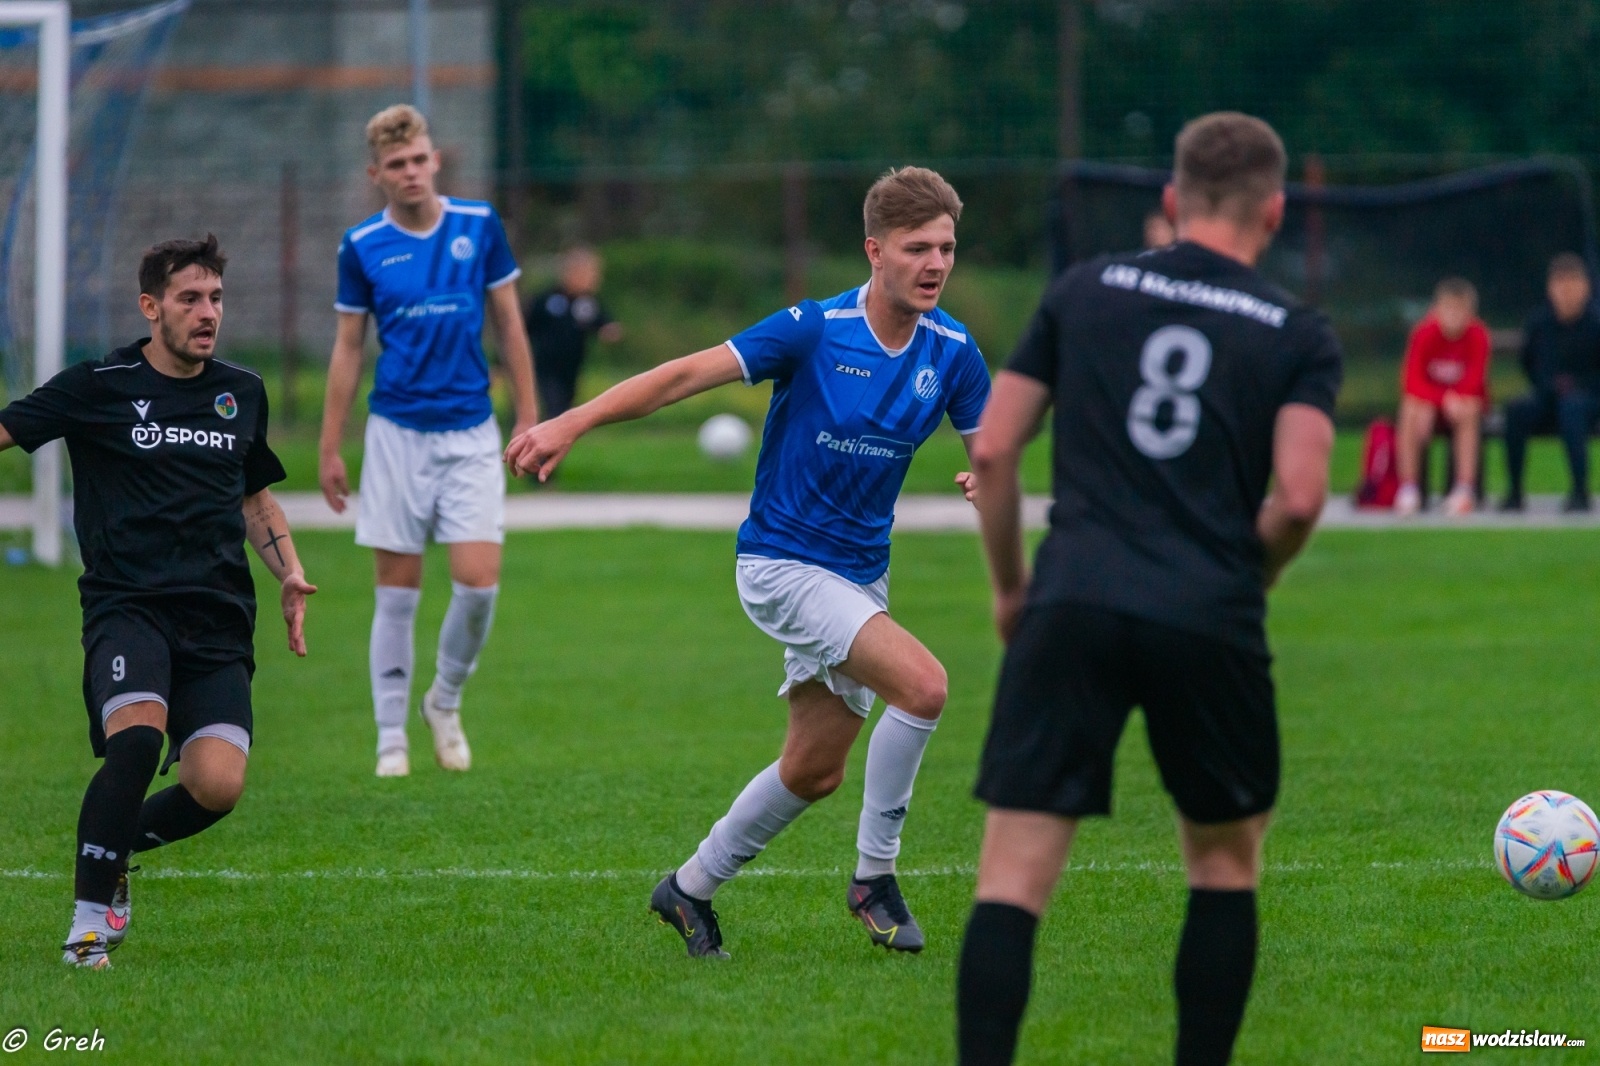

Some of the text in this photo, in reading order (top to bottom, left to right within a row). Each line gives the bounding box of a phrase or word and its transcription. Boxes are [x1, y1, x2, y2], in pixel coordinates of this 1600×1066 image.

[835, 364, 872, 378] zina
[1127, 324, 1213, 460] 8
[165, 427, 236, 450] SPORT
[815, 431, 896, 458] Pati Trans
[111, 655, 126, 682] 9
